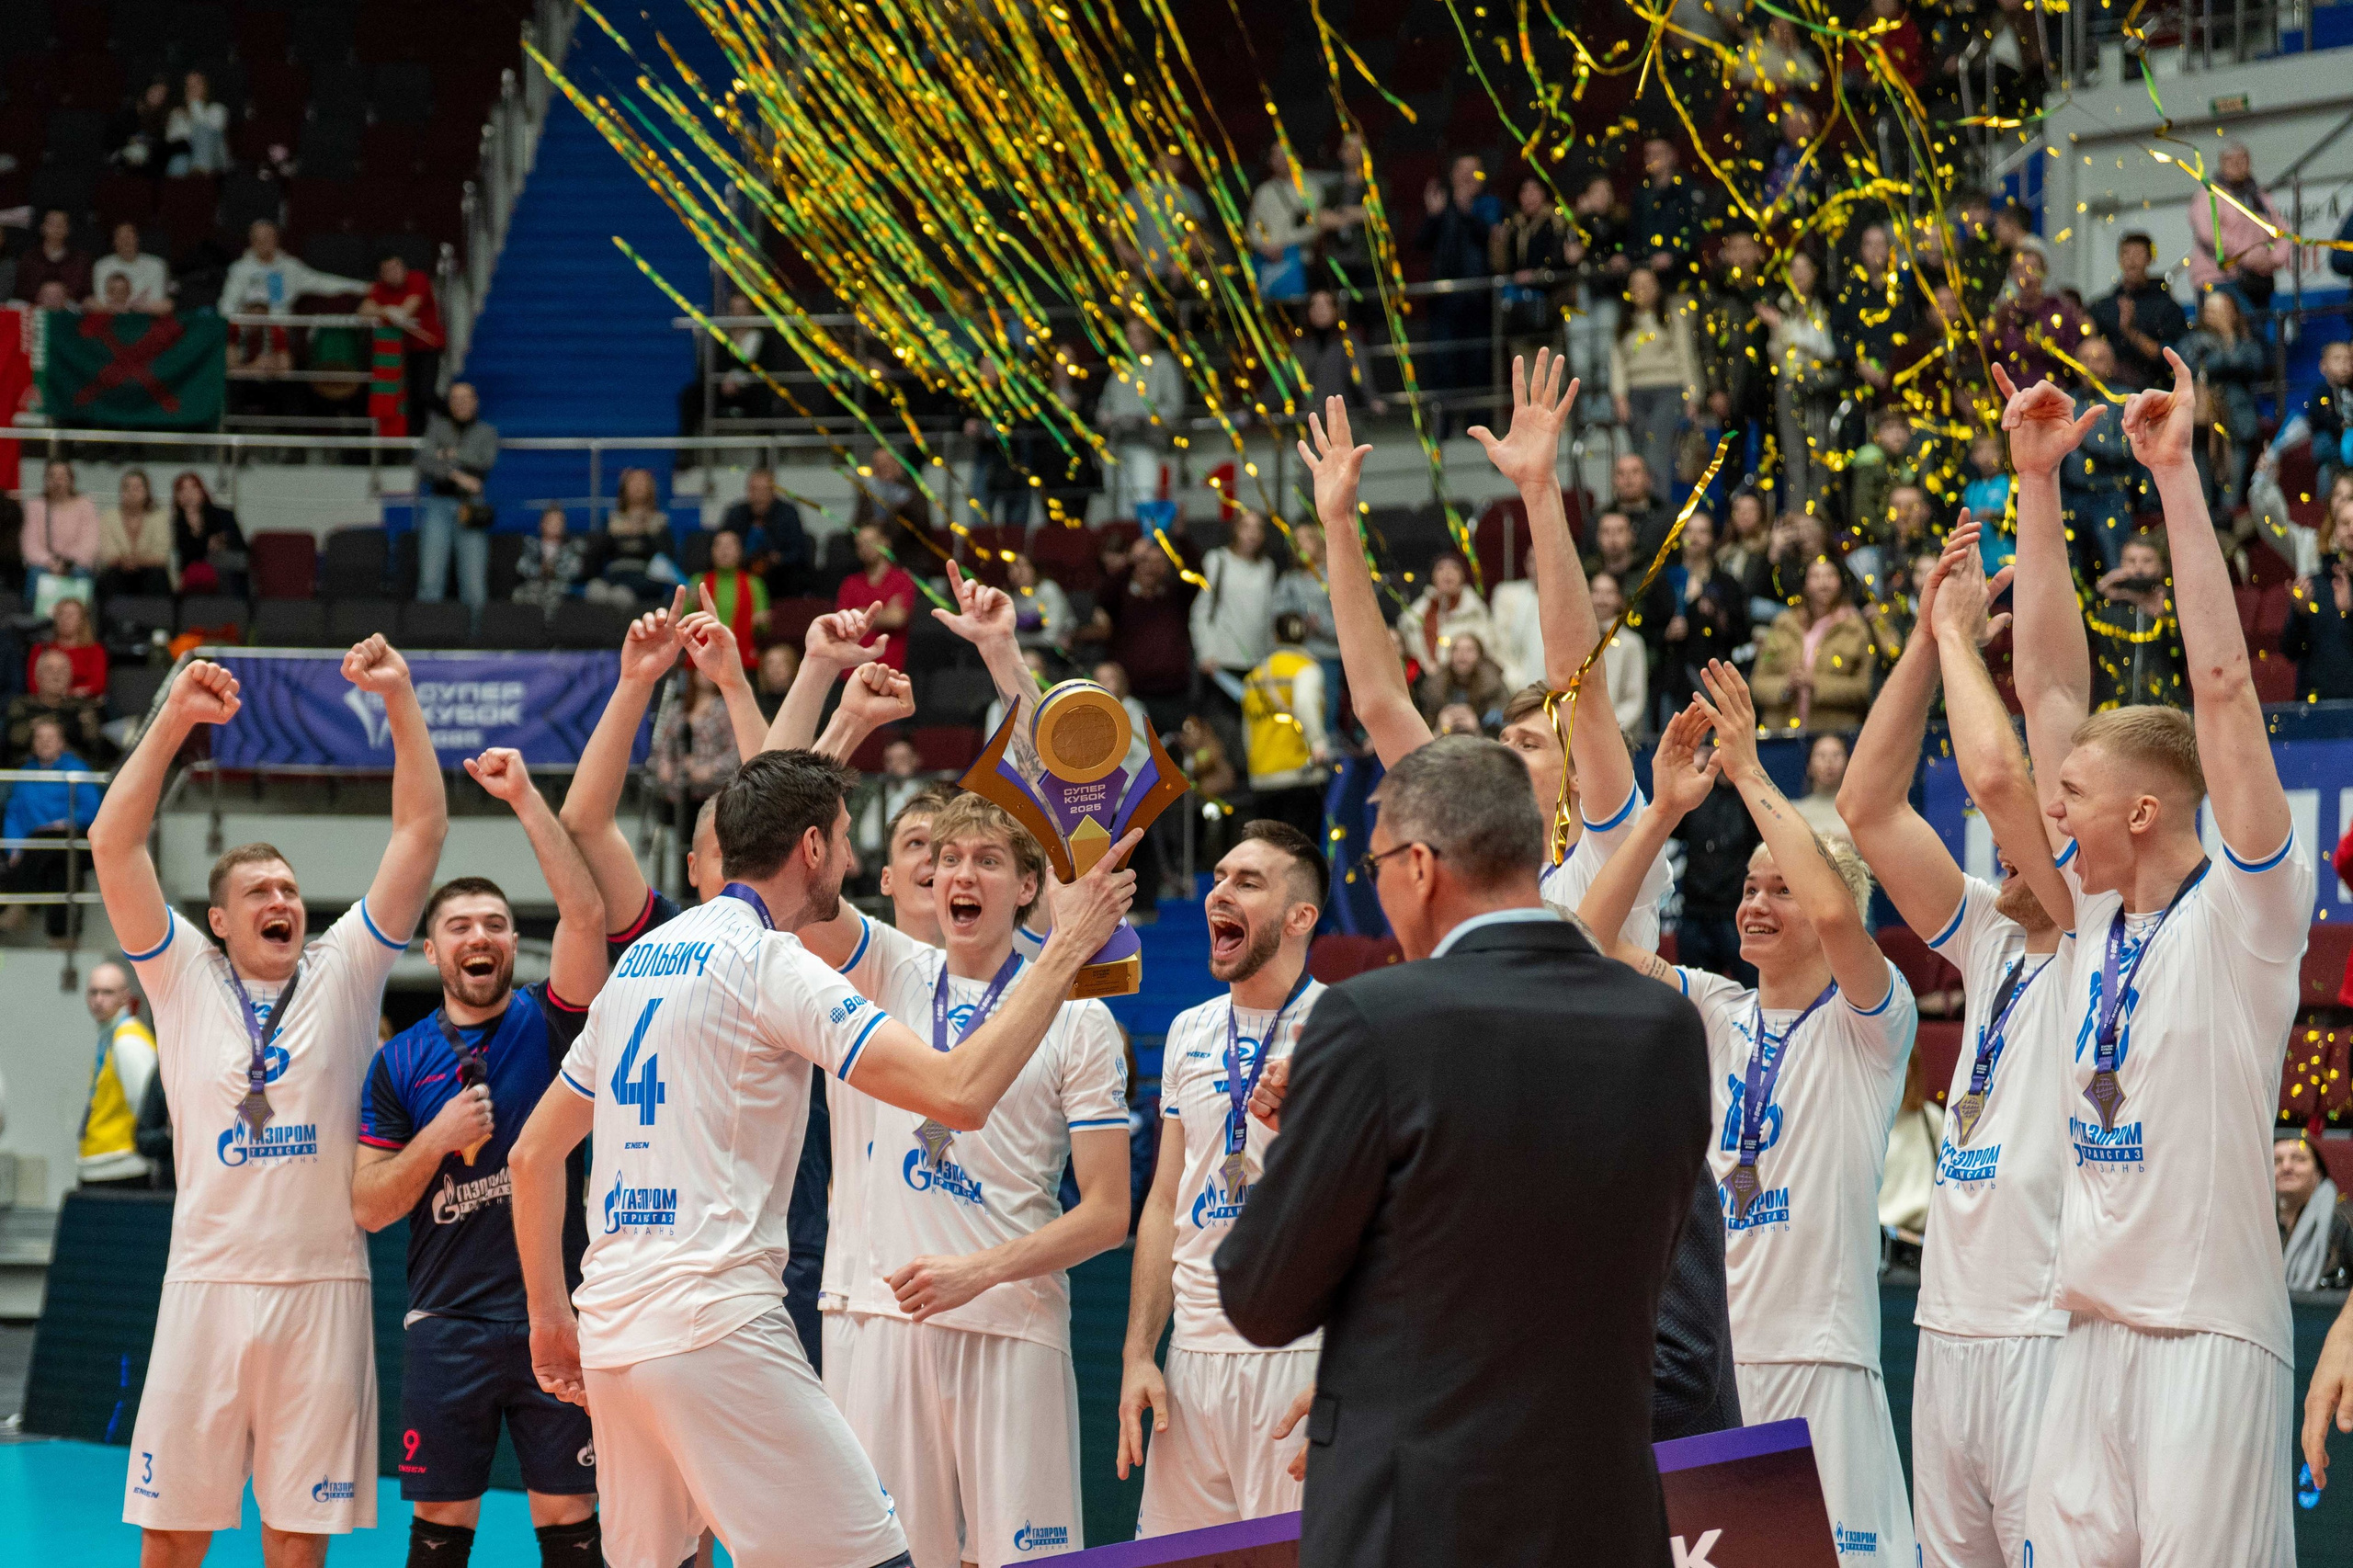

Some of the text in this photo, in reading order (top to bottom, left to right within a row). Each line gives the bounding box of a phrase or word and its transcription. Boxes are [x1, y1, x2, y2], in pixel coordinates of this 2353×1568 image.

[1063, 784, 1106, 796] СУПЕР
[1064, 791, 1107, 803] КУБОК
[1070, 802, 1102, 814] 2025
[617, 941, 715, 978] ВОЛЬВИЧ
[610, 997, 665, 1126] 4
[250, 1145, 316, 1157] ТРАНСГАЗ
[249, 1156, 317, 1166] КАЗАНЬ
[404, 1429, 420, 1461] 9
[142, 1452, 153, 1484] 3
[1032, 1527, 1067, 1538] ГАЗПРОМ
[1846, 1531, 1876, 1543] ГАЗПРОМ
